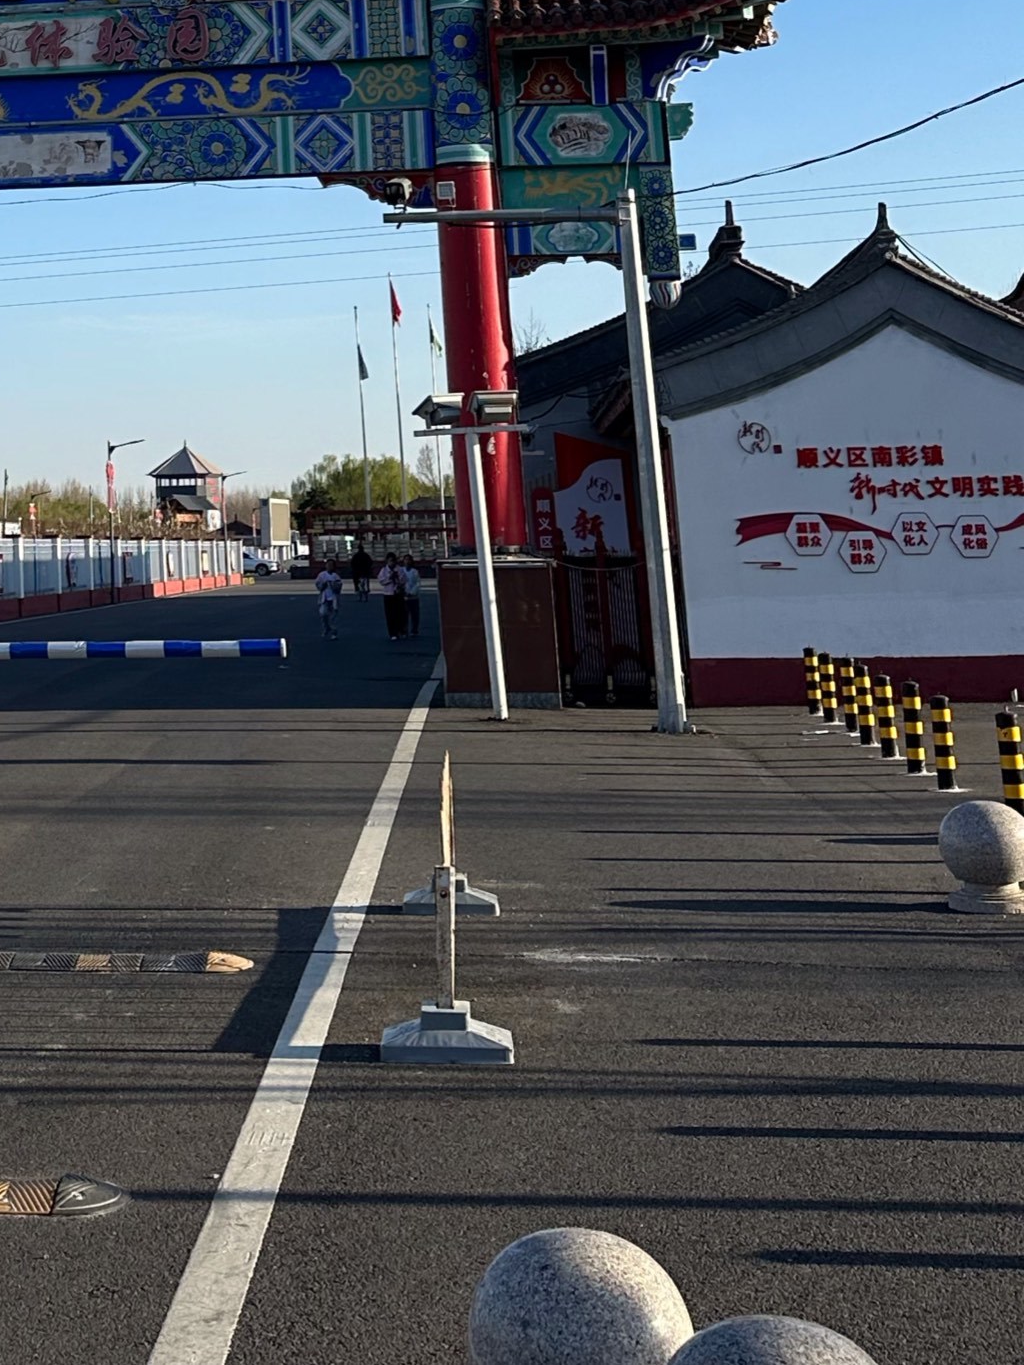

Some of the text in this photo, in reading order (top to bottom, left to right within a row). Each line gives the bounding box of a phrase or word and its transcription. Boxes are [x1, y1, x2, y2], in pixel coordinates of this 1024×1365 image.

[796, 444, 945, 469] 顺义区南彩镇
[535, 498, 554, 549] 顺义区
[901, 521, 927, 533] 以文
[961, 524, 987, 536] 成风
[797, 535, 823, 548] 群众
[849, 539, 874, 551] 引导
[904, 535, 929, 547] 化人
[963, 537, 989, 550] 化俗
[850, 553, 876, 565] 群众
